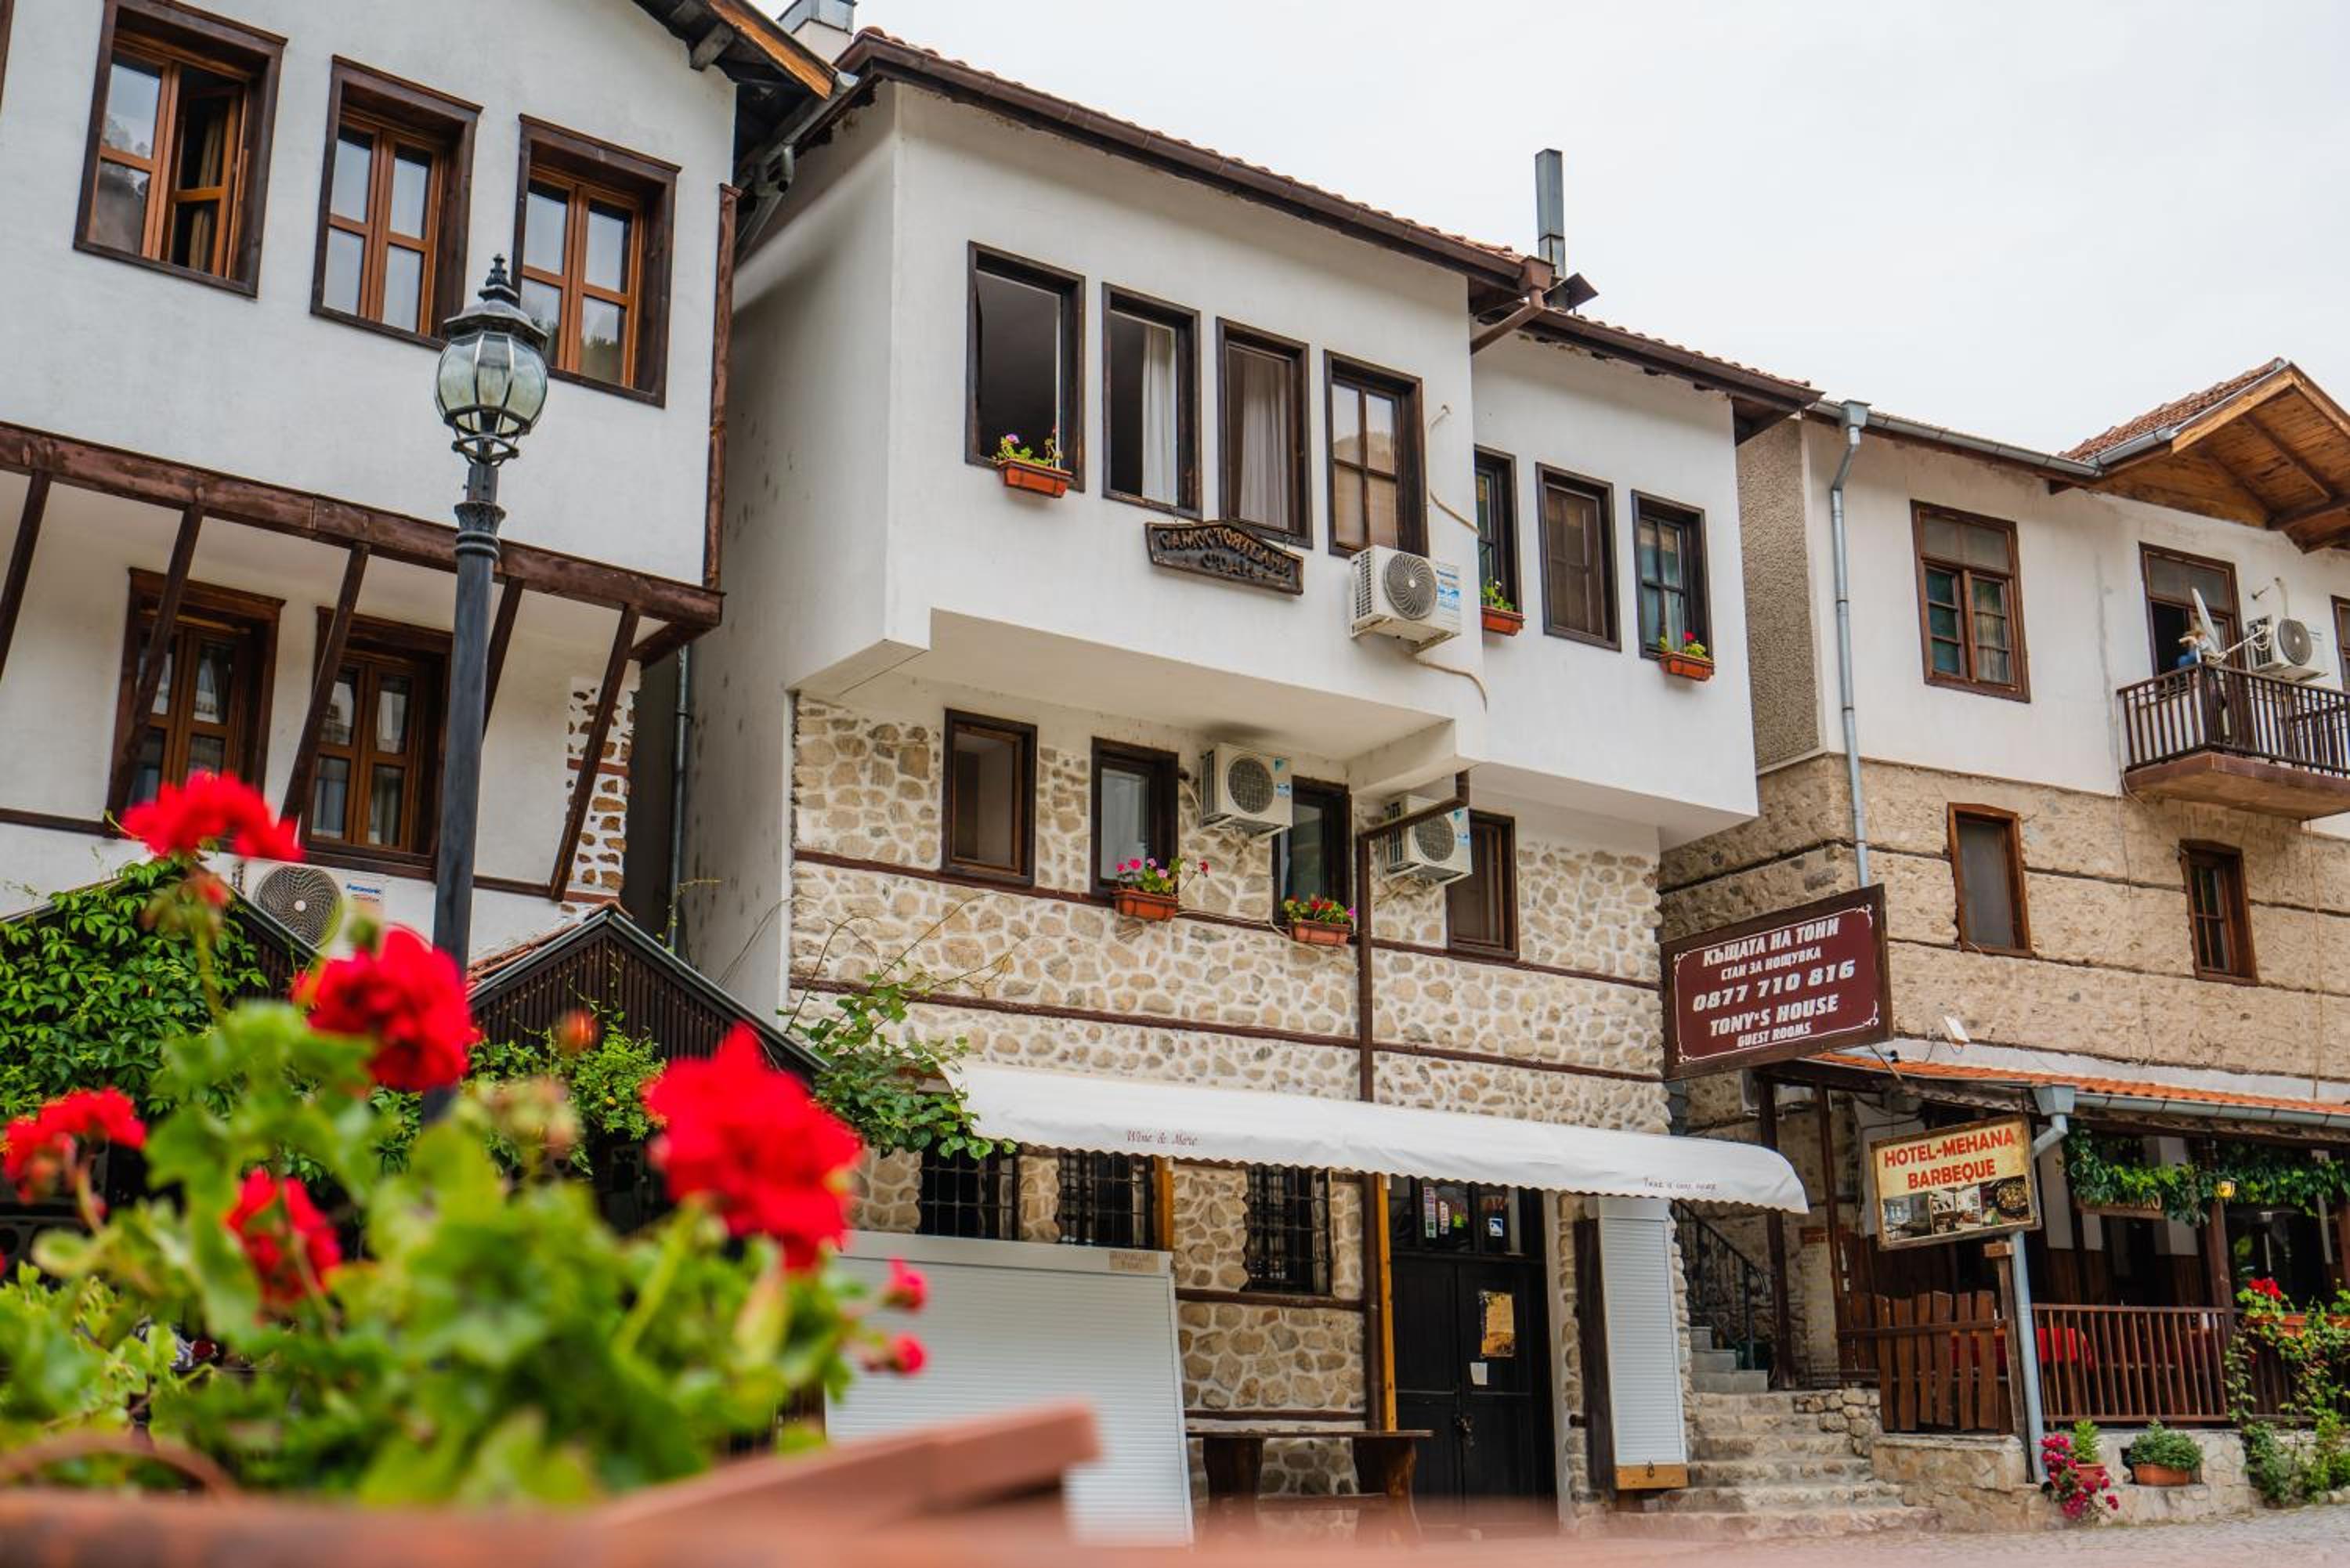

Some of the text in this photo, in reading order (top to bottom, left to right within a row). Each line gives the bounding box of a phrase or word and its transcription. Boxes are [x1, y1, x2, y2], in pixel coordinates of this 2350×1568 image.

[1703, 917, 1841, 967] КЪЩАТА НА ТОНИ
[1748, 960, 1763, 975] ЗА
[1765, 946, 1822, 971] НОЩУВКА
[1692, 959, 1856, 1012] 0877 710 816
[1710, 993, 1839, 1036] TONY'S HOUSE
[1737, 1021, 1812, 1048] GUEST ROOMS
[1157, 1132, 1166, 1144] &
[1883, 1127, 2016, 1169] HOTEL-MEHANA
[1907, 1158, 1997, 1190] BARBEQUE
